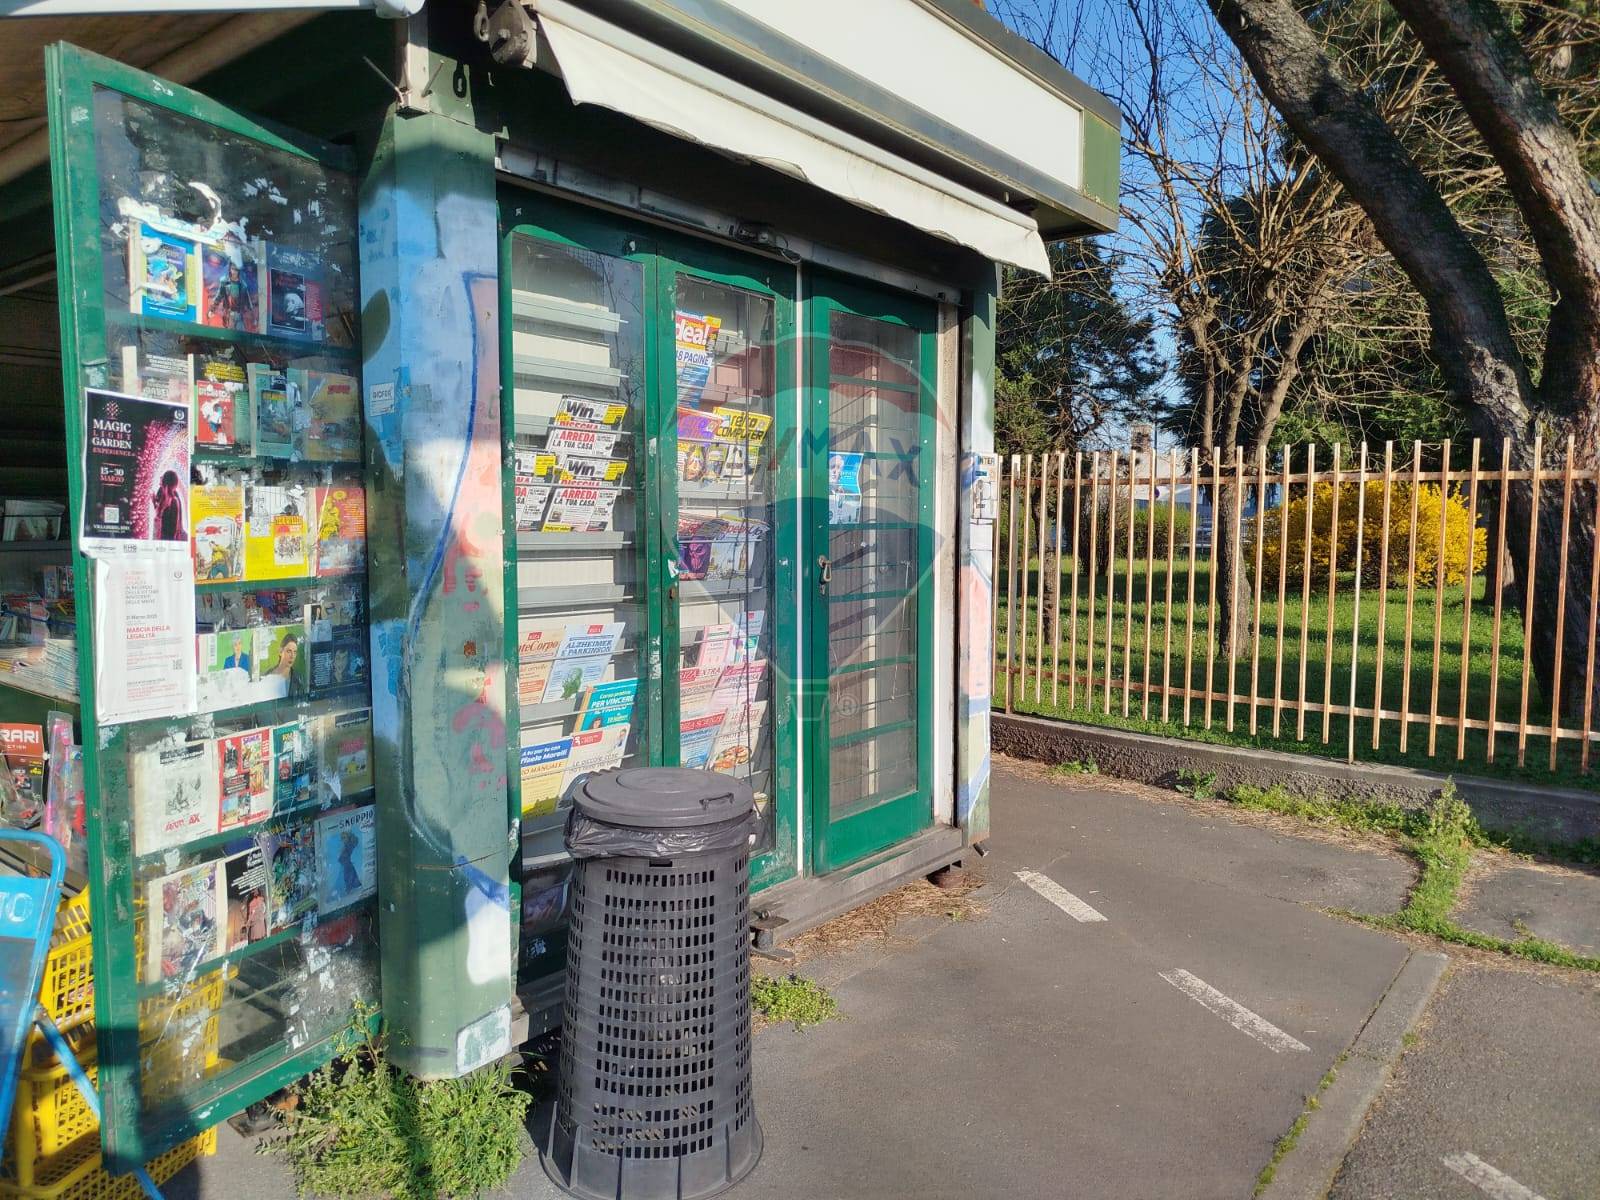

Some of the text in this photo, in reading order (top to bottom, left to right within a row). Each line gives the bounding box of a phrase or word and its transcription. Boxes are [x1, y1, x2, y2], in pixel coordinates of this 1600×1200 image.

[683, 352, 709, 365] PAGINE
[566, 400, 594, 418] Win
[93, 419, 132, 433] MAGIC
[92, 431, 132, 441] LIGHT
[559, 431, 596, 443] ARREDA
[717, 425, 765, 441] COMPUTER
[92, 437, 132, 449] GARDEN
[552, 440, 593, 451] LA TUA CASA
[568, 460, 596, 477] Win
[100, 475, 125, 483] MARZO
[561, 488, 598, 500] ARREDA
[565, 498, 578, 506] TUA
[579, 499, 595, 507] CASA
[606, 695, 635, 706] VINCERE
